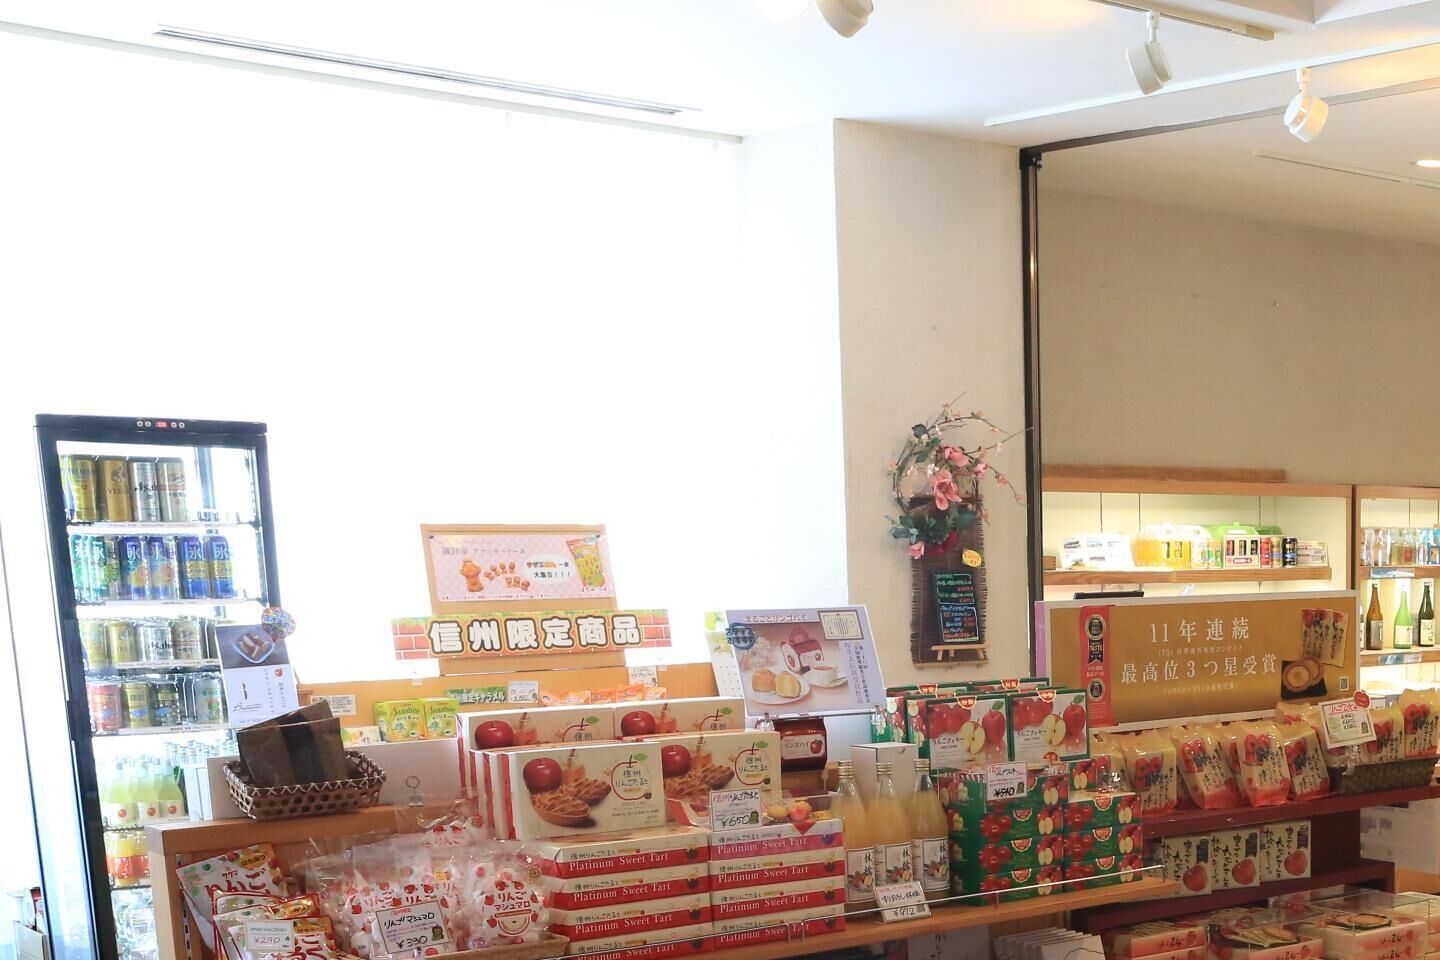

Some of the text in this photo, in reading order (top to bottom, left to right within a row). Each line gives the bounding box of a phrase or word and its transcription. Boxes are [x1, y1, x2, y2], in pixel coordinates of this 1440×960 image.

[429, 614, 643, 656] 信州限定商品
[1150, 616, 1249, 643] 11年連続
[1121, 654, 1277, 685] 最高位3つ星受賞
[739, 764, 769, 773] りんごたると
[746, 756, 762, 764] 信州
[623, 770, 641, 778] 信州
[615, 779, 649, 787] りんごたると
[717, 836, 808, 854] Platinum Sweet Tart
[569, 852, 669, 872] Platinum Sweet Tart
[719, 866, 809, 883] Platinum Sweet Tart
[497, 891, 527, 902] りんご
[574, 883, 671, 902] Platinum Sweet Tart
[494, 901, 531, 911] マシュマロ
[720, 895, 809, 913] Platinum Sweet Tart
[575, 914, 673, 934] Platinum Sweet Tart
[720, 931, 760, 943] Platinum
